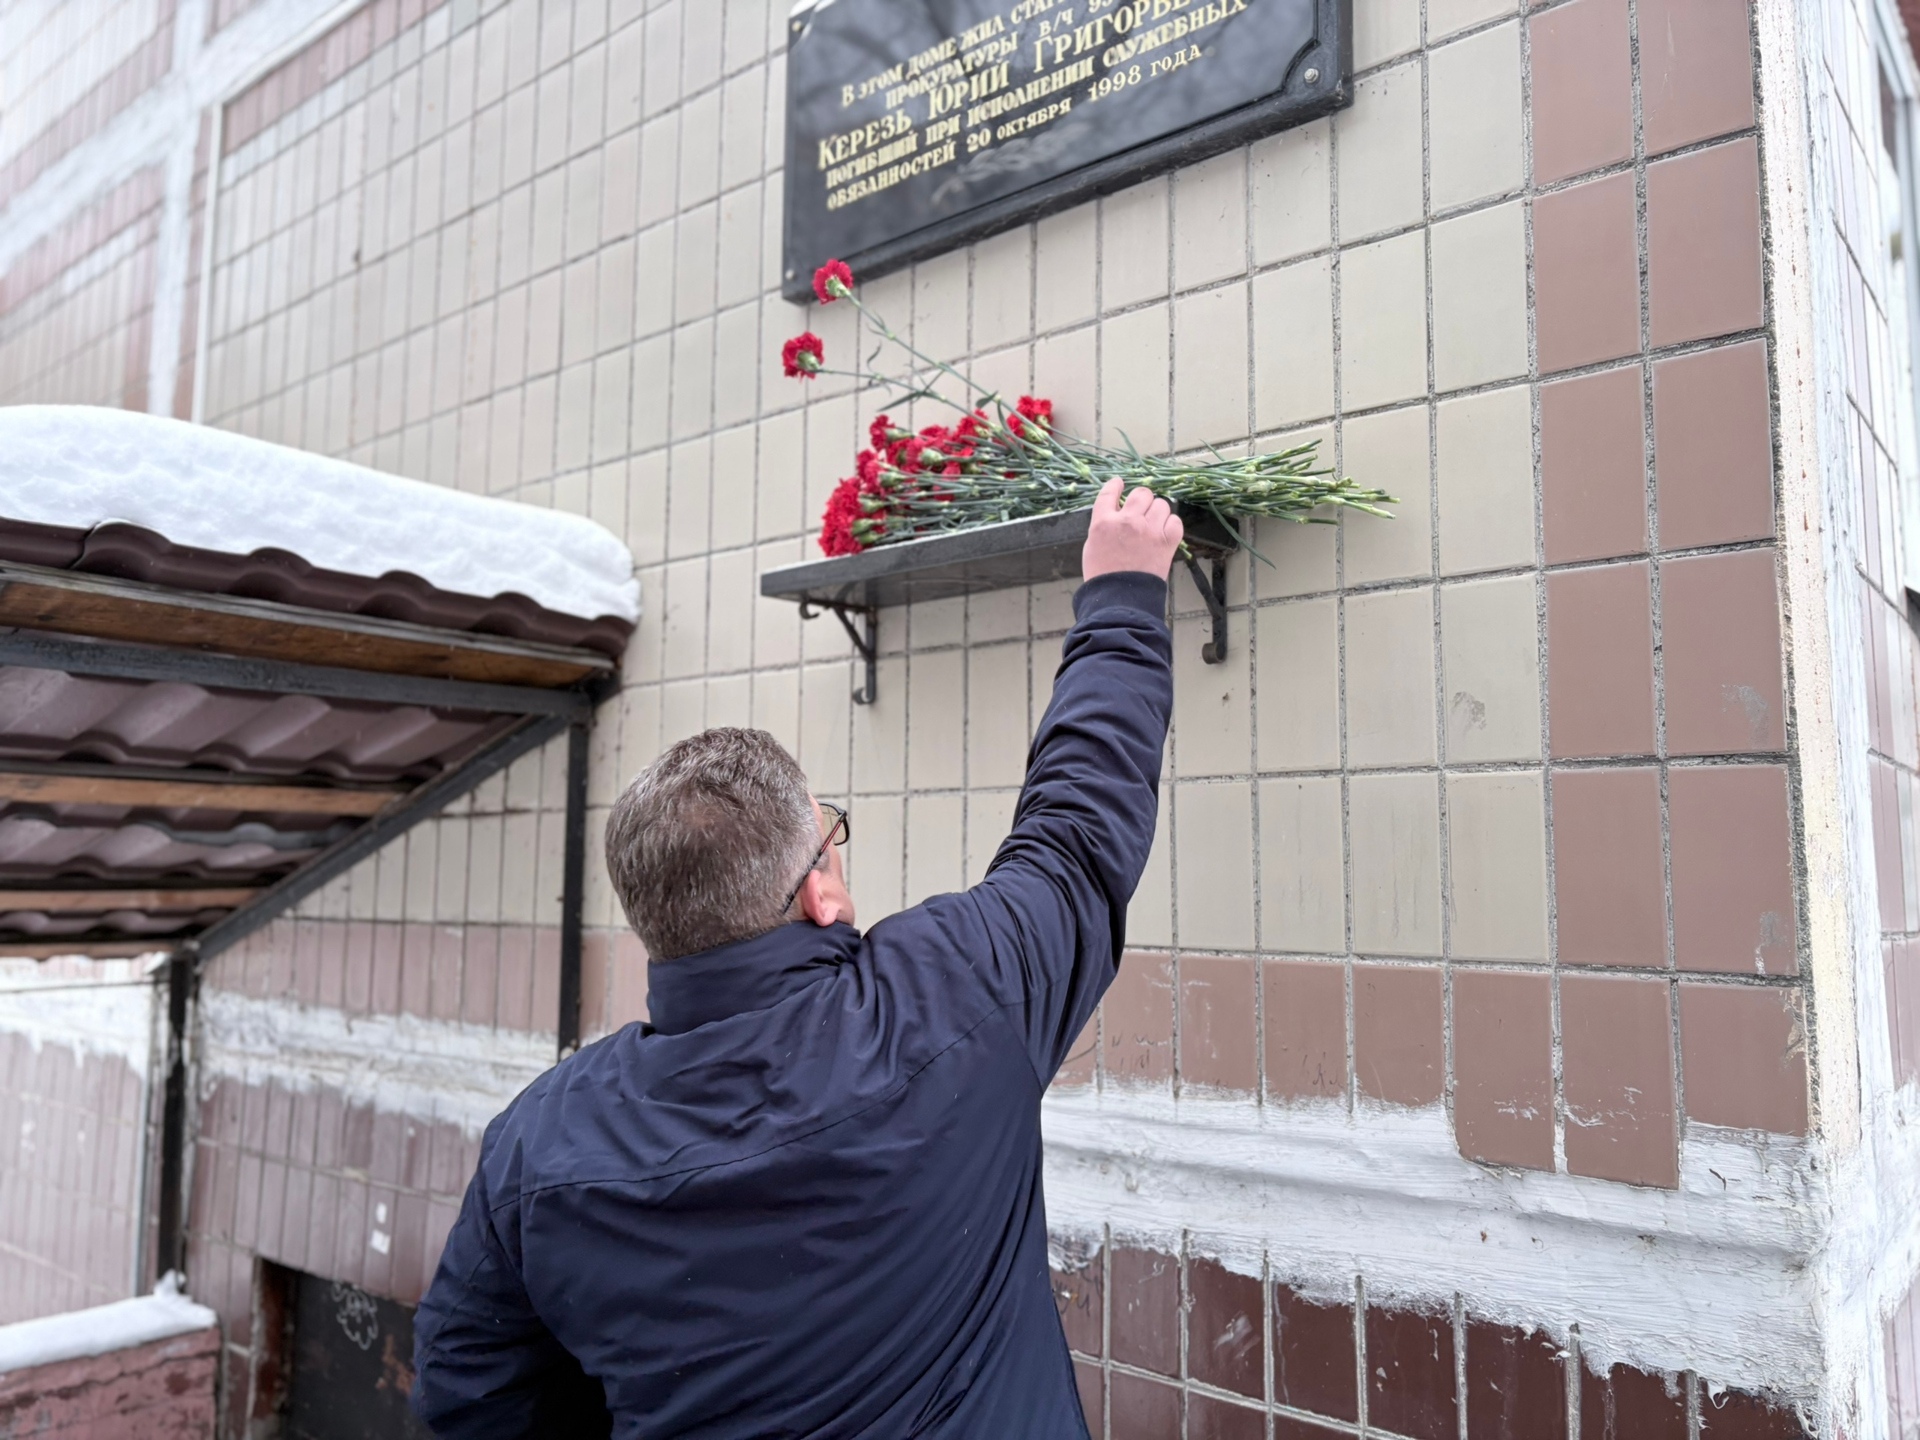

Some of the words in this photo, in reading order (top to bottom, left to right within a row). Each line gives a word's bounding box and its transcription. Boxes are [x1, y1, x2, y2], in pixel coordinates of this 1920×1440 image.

[819, 108, 912, 170] КЕРЕЗЬ
[928, 58, 1010, 120] ЮРИЙ
[826, 130, 919, 189] ПОГИБШИЙ
[925, 114, 960, 146] ПРИ
[967, 55, 1095, 127] ИСПОЛНЕНИИ
[1102, 0, 1248, 68] СЛУЖЕБНЫХ
[842, 84, 855, 107] В
[858, 63, 903, 99] ЭТОМ
[905, 37, 958, 80] ДОМЕ
[960, 14, 1005, 50] ЖИЛ
[886, 31, 1018, 109] ПРОКУРАТУРЫ
[827, 139, 957, 210] ОБЯЗАННОСТЕЙ
[966, 128, 991, 153] 20
[996, 97, 1072, 140] ОКТЯБРЯ
[1087, 64, 1142, 102] 1998
[1150, 44, 1202, 77] ГОДА
